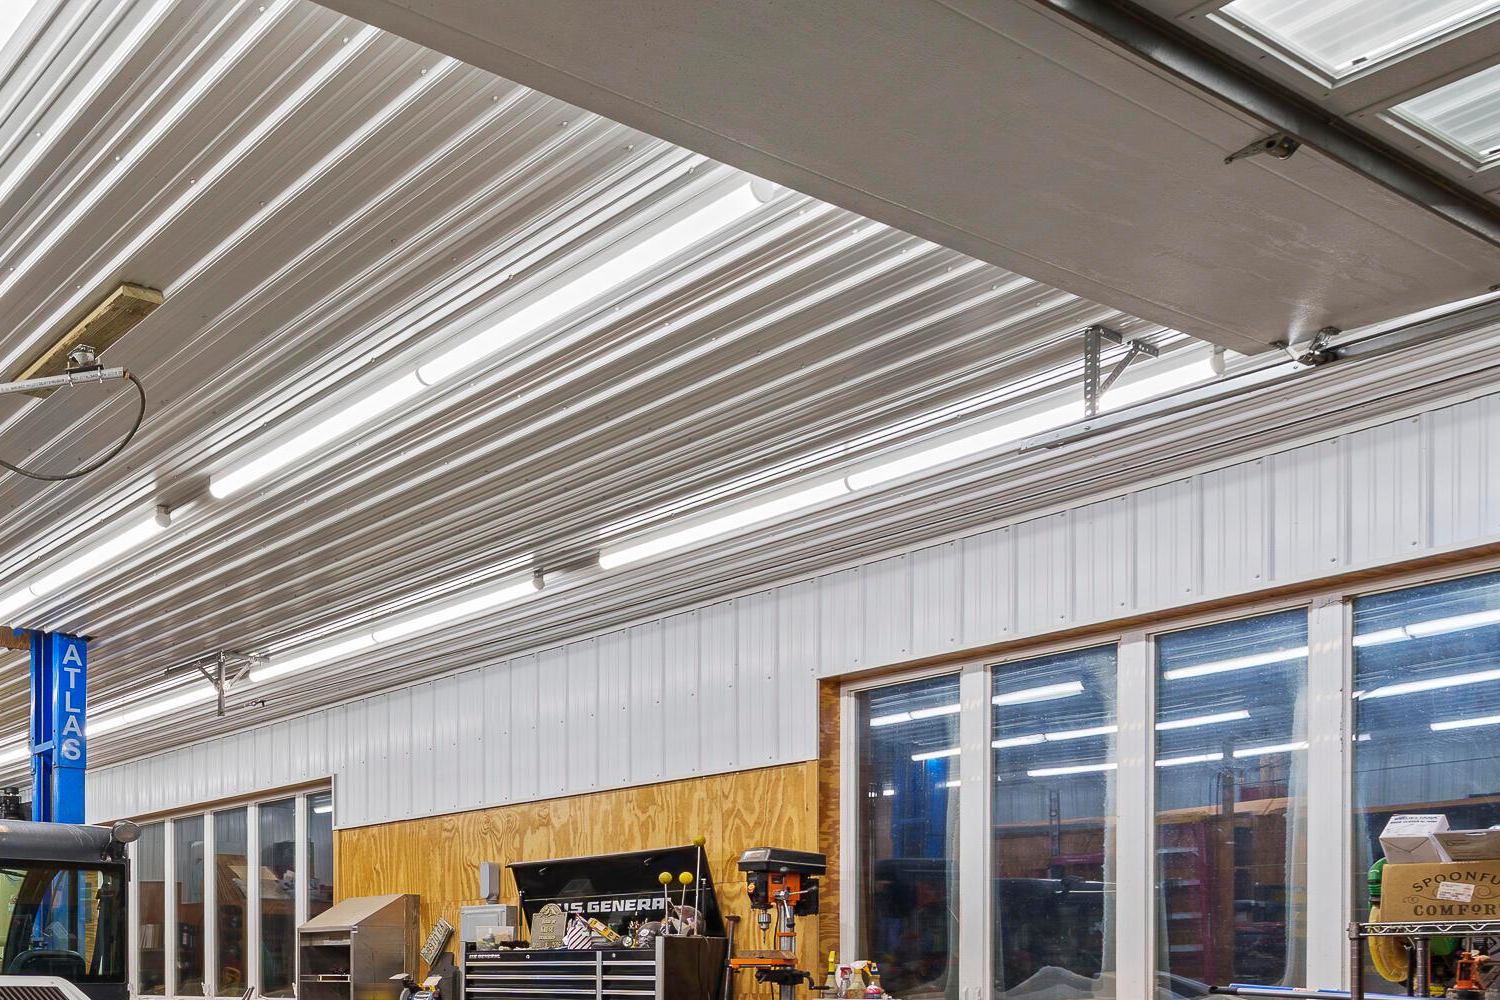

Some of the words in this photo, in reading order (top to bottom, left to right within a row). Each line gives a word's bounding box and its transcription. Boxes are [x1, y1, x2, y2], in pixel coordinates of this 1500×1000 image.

[62, 644, 83, 760] ATLAS
[587, 897, 671, 913] GENERA
[1413, 903, 1500, 916] COMFOR
